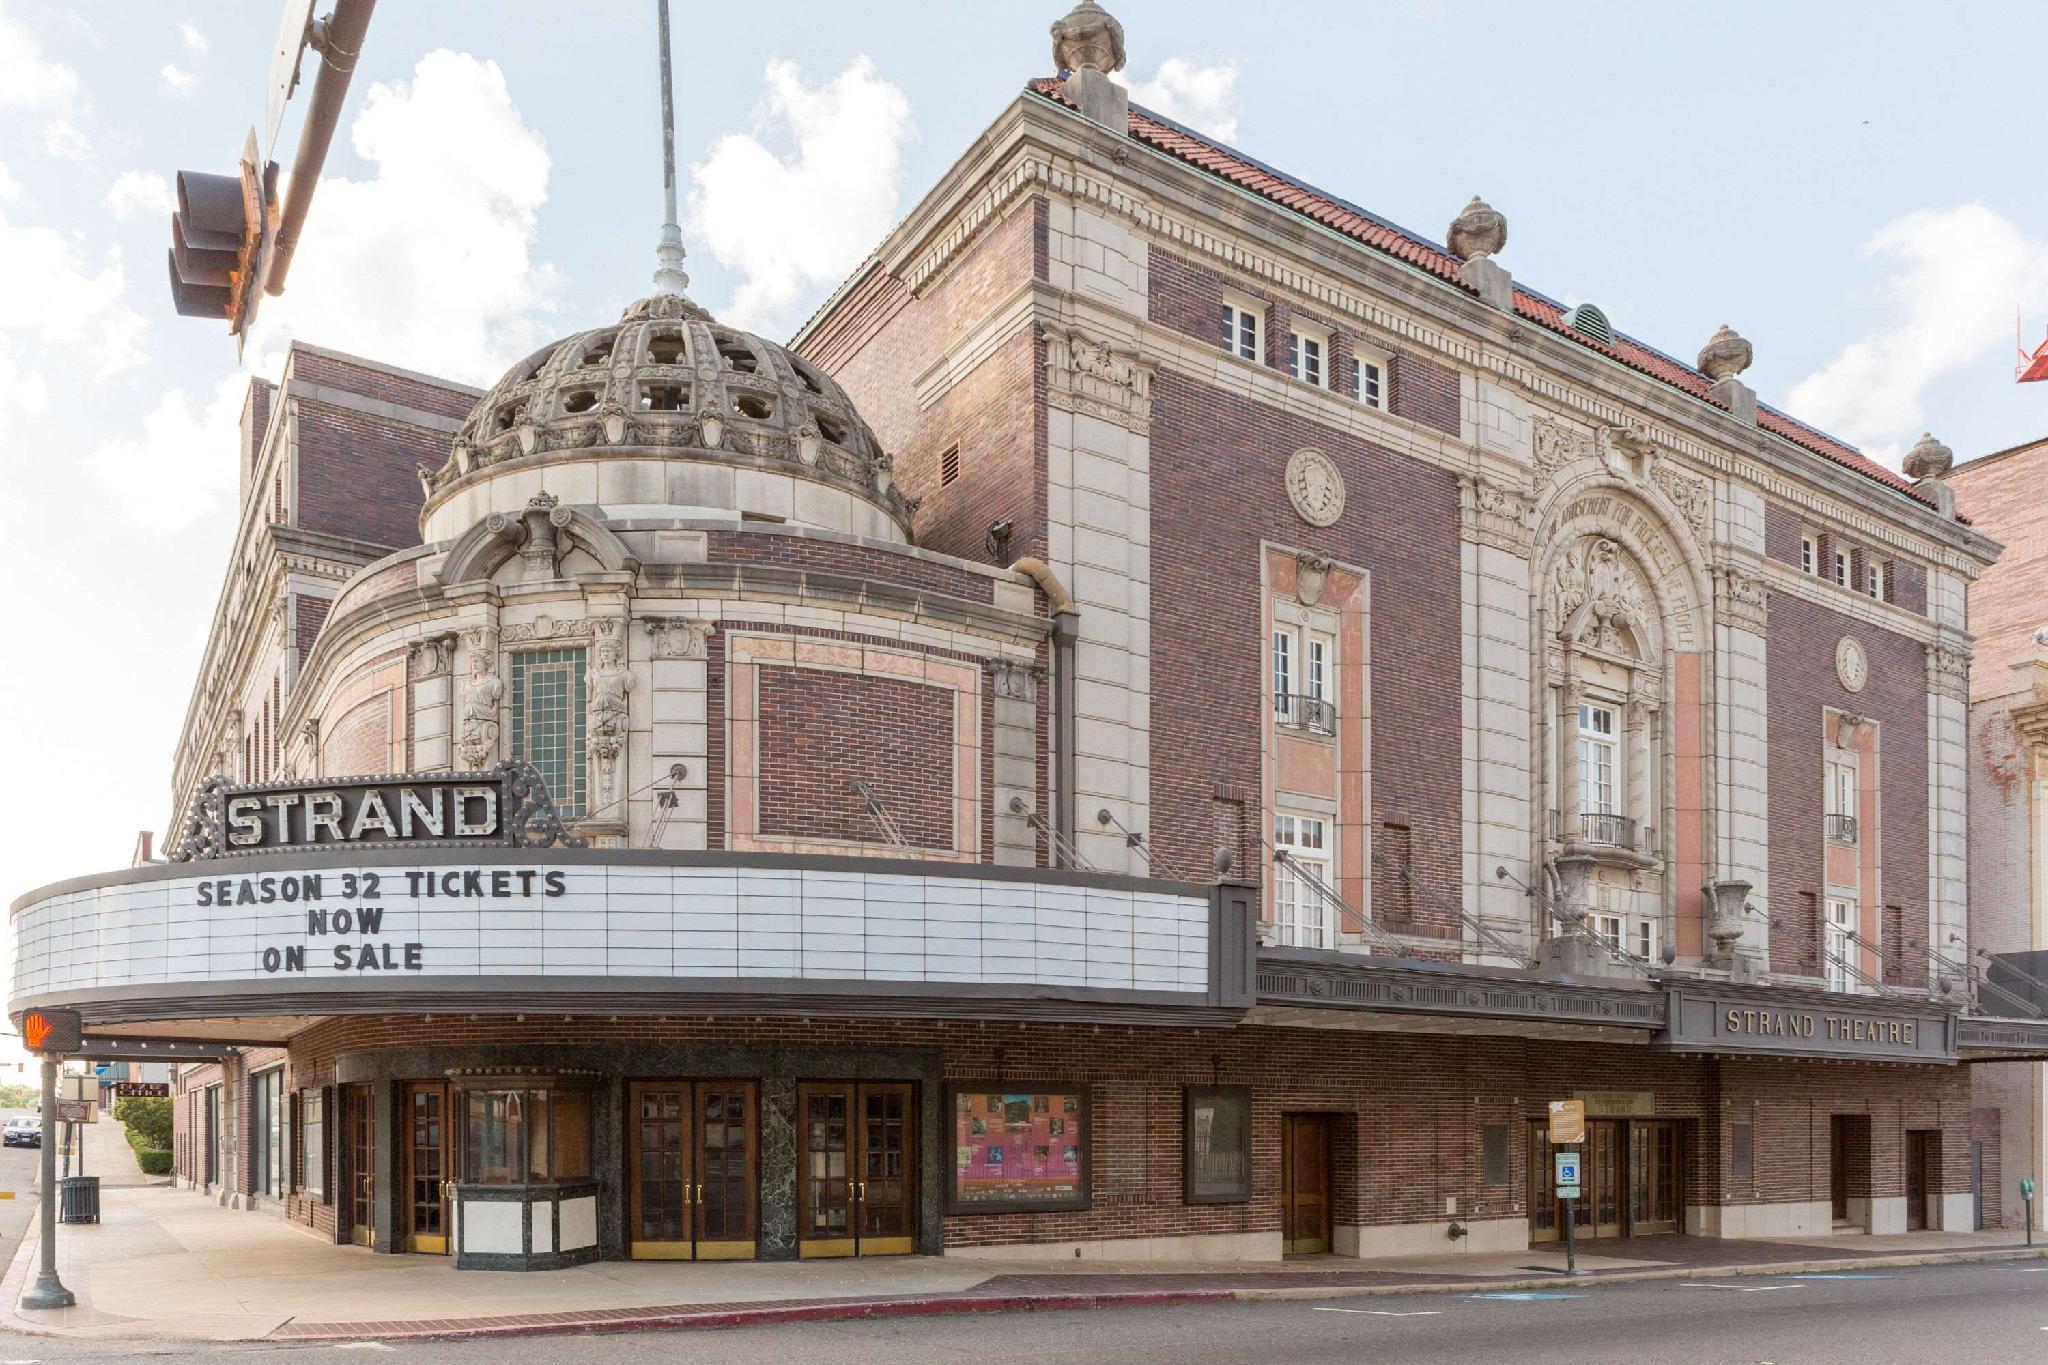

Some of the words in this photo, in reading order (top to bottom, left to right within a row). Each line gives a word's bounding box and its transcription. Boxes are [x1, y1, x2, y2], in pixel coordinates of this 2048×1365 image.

[1611, 502, 1633, 526] FOR
[1672, 595, 1695, 649] PEOPLE
[228, 787, 497, 846] STRAND
[197, 874, 322, 906] SEASON
[342, 872, 381, 899] 32
[405, 870, 566, 898] TICKETS
[308, 907, 384, 935] NOW
[262, 945, 305, 972] ON
[334, 943, 423, 970] SALE
[1727, 1009, 1814, 1037] STRAND
[1826, 1017, 1913, 1044] THEATRE
